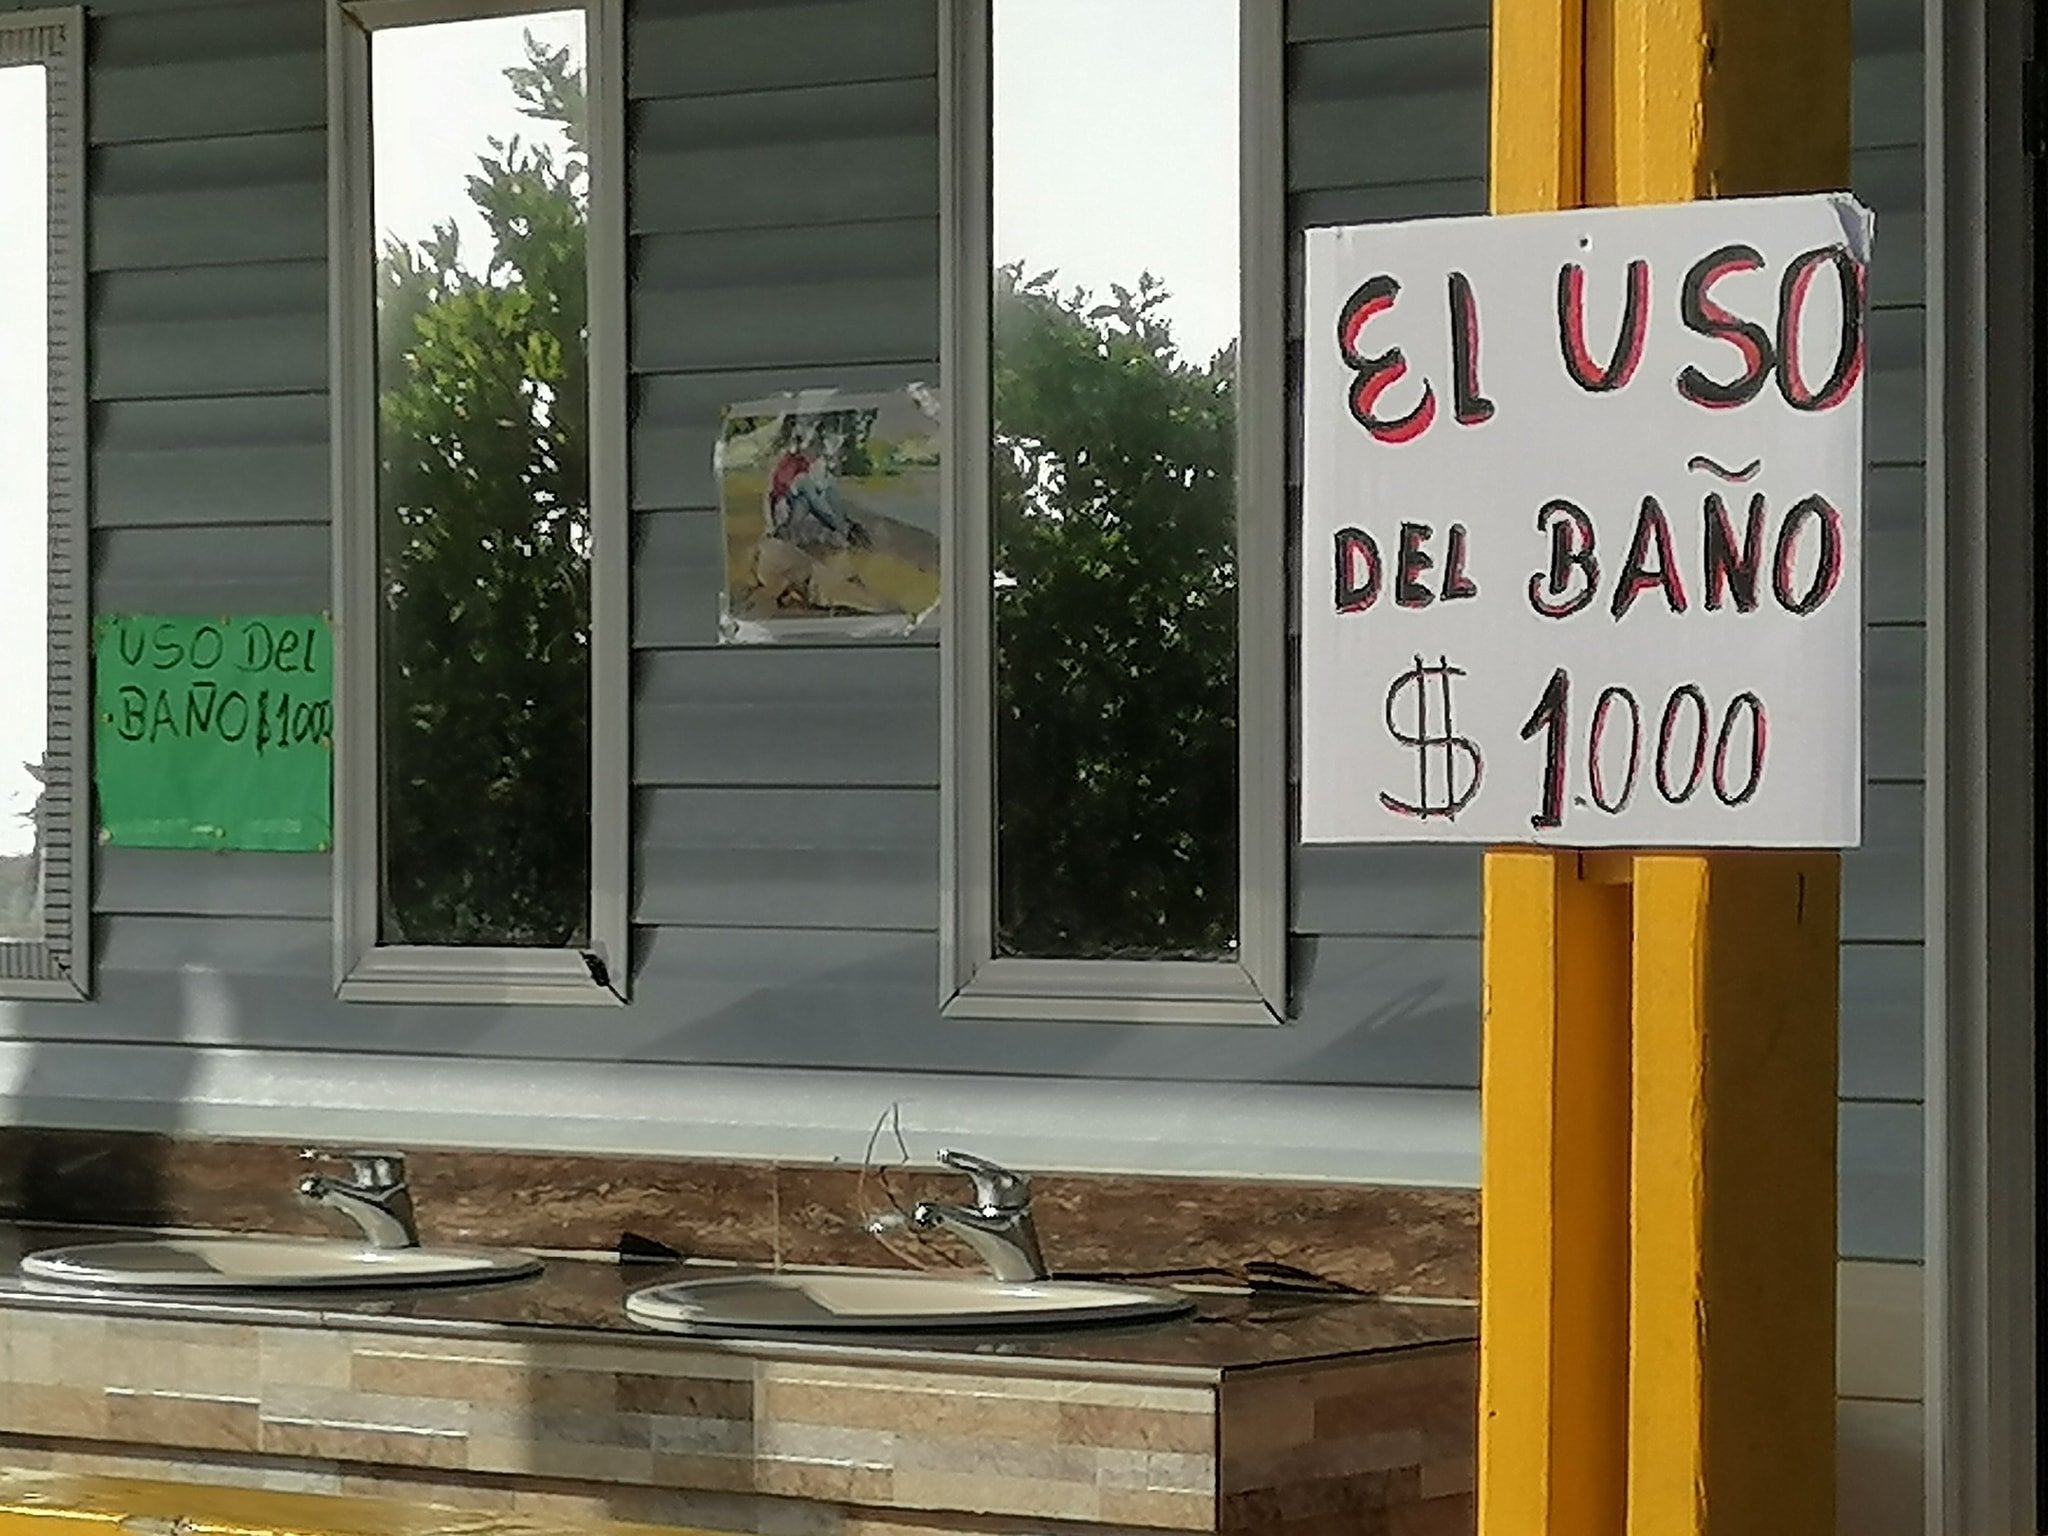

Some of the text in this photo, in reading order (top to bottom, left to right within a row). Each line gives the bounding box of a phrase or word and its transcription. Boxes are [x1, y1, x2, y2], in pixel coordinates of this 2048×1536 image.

[1557, 244, 1867, 412] USO
[1334, 456, 1844, 622] DEL BAÑO
[119, 623, 224, 670] USO
